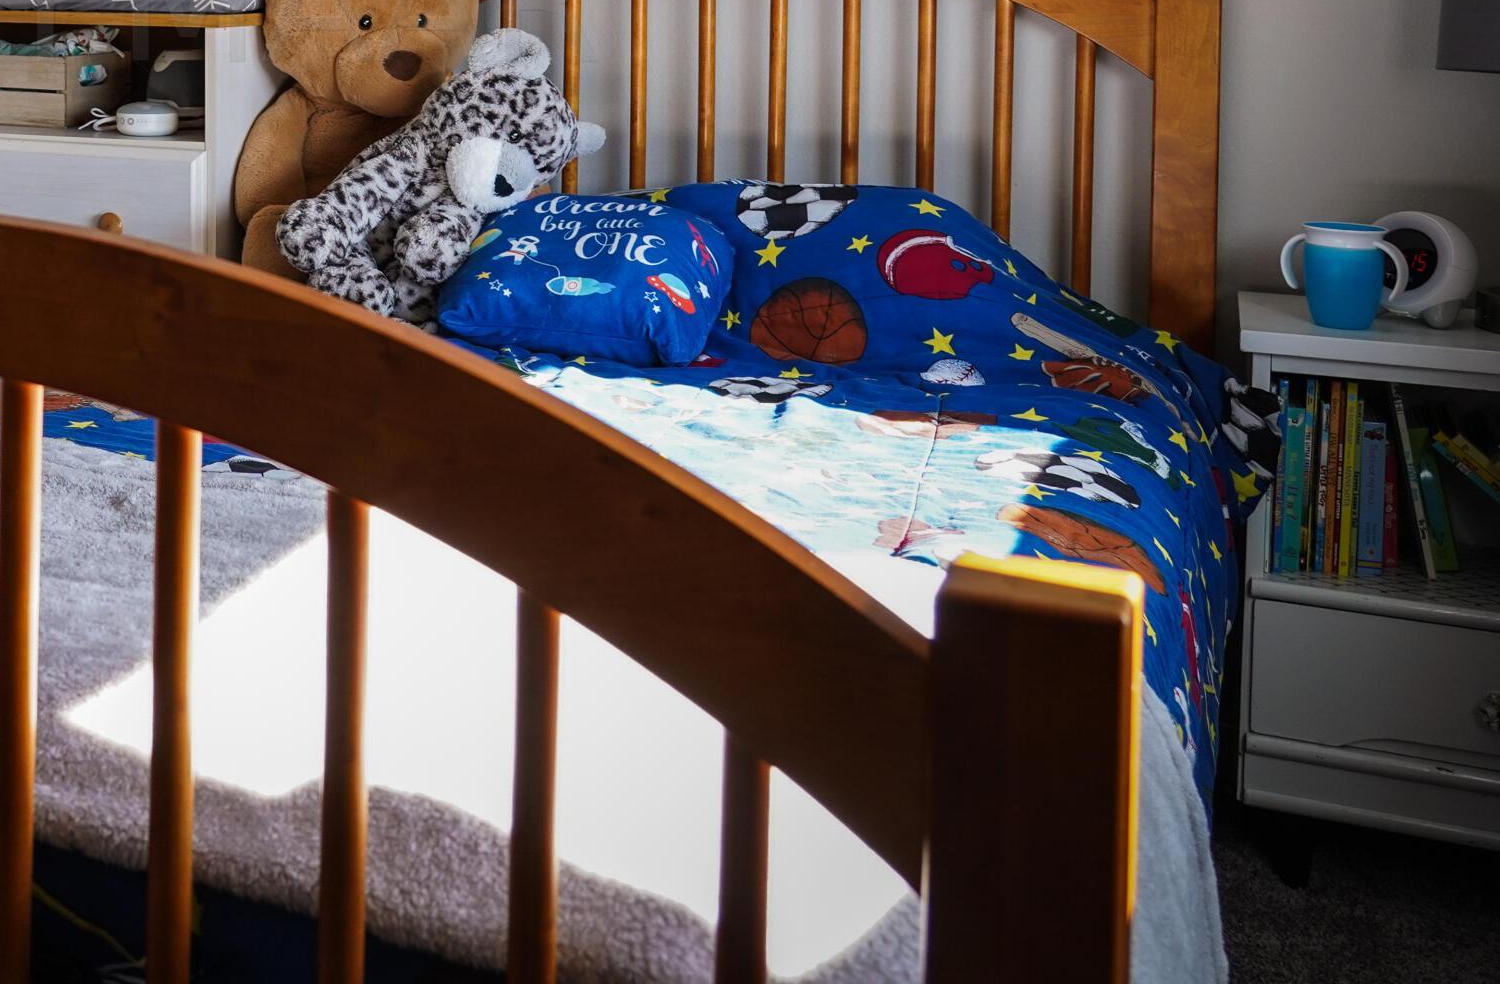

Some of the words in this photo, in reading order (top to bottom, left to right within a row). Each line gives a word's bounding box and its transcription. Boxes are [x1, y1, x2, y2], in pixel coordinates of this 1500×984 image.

[533, 195, 671, 217] dream
[539, 215, 588, 241] big
[595, 217, 645, 230] little
[573, 230, 669, 267] ONE
[1320, 464, 1328, 487] LITTLE
